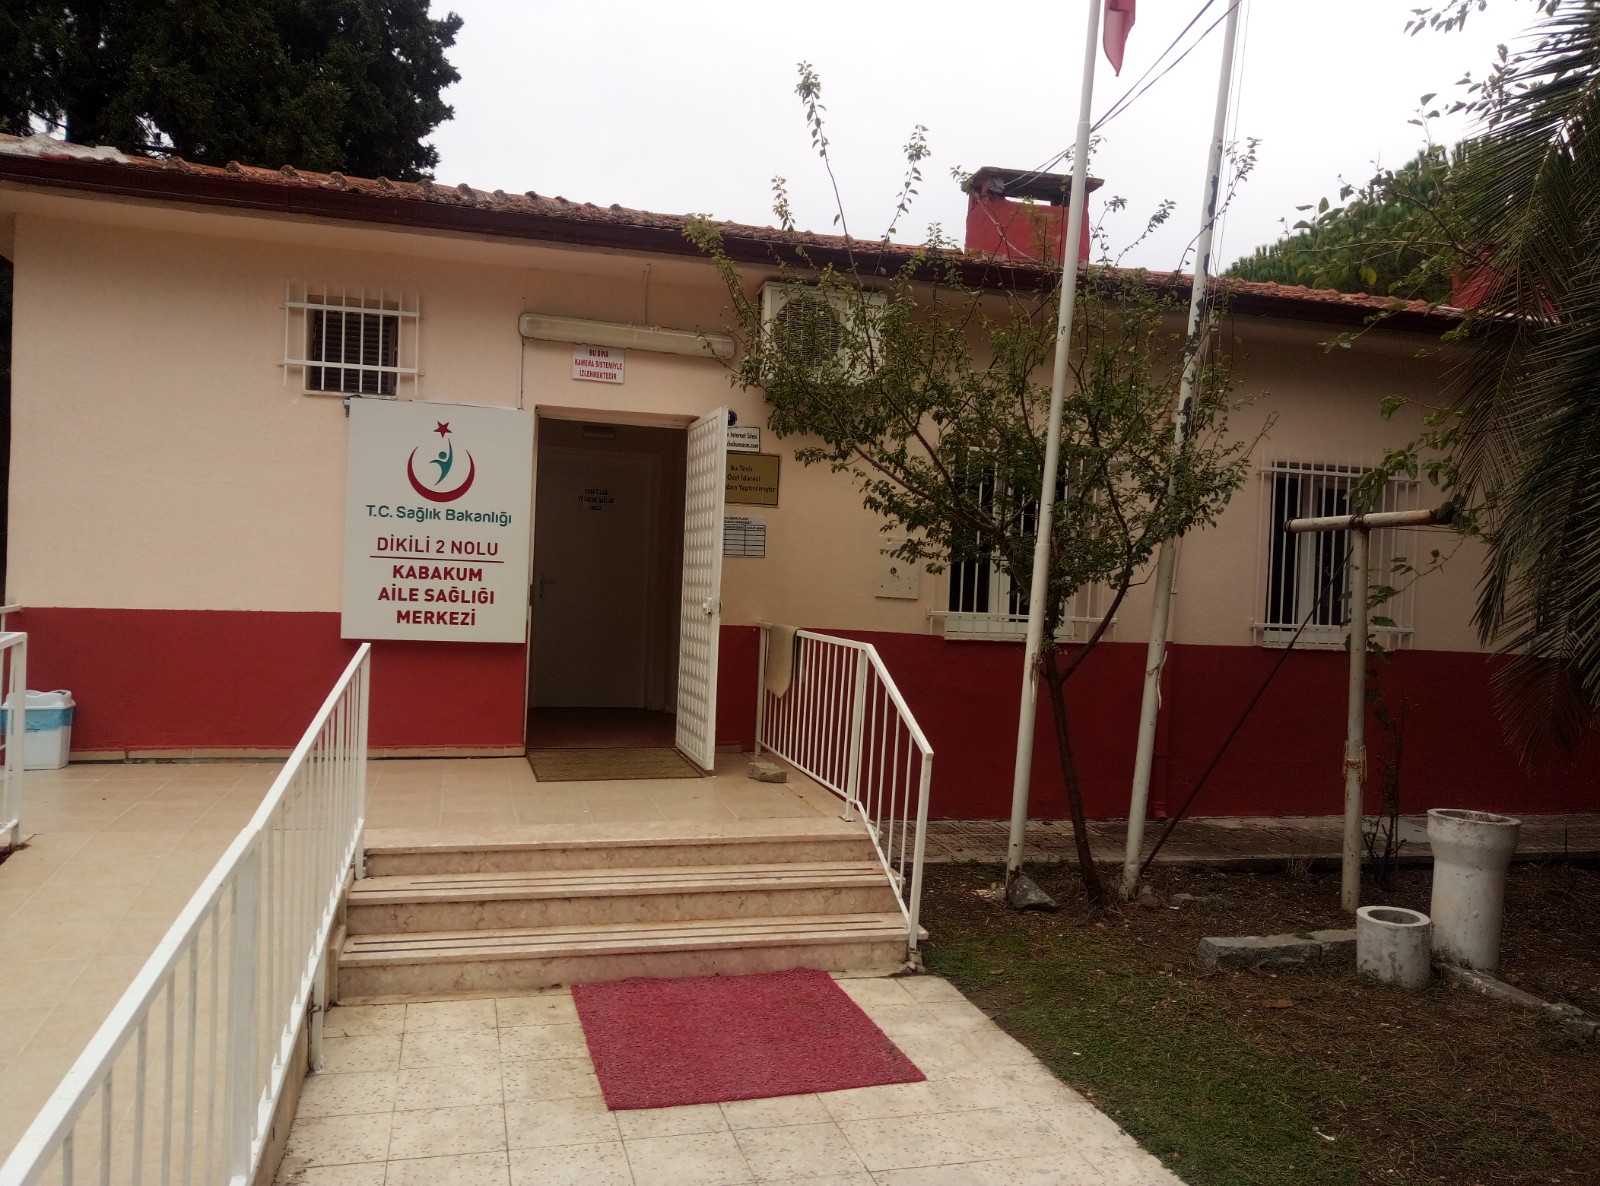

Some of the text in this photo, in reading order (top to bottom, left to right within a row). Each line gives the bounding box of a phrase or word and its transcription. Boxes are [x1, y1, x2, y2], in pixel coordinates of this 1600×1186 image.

[589, 349, 596, 357] BU
[574, 358, 594, 368] KAMERA
[727, 473, 740, 481] Özel
[366, 504, 512, 527] T.C. Sağlık Bakanlığı
[377, 533, 499, 556] DİKİLİ 2 NOLU
[392, 564, 483, 582] KABAKUM
[377, 583, 495, 605] AİLE SAĞLIĞI
[396, 608, 476, 626] MERKEZİ
